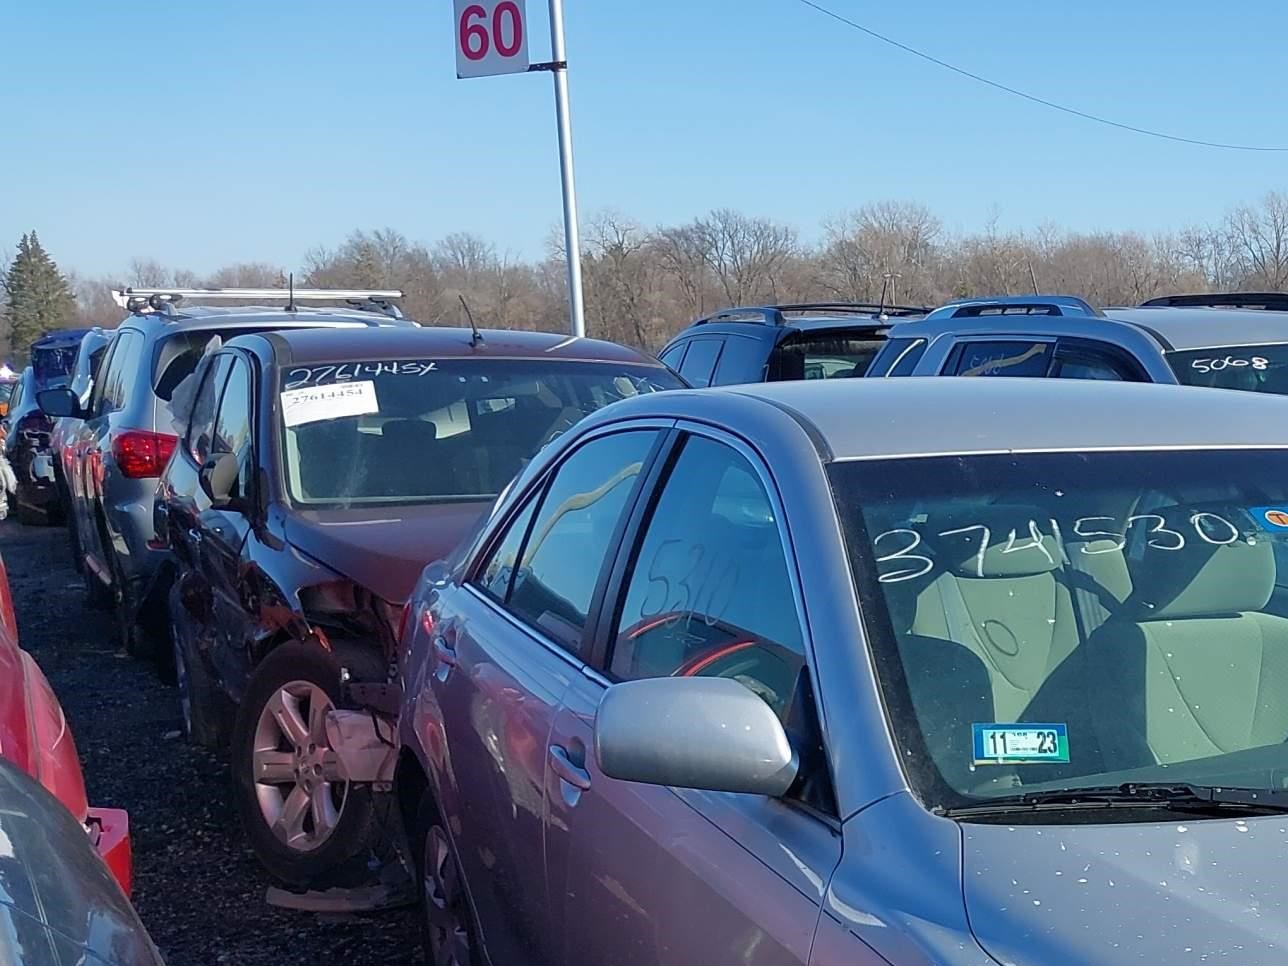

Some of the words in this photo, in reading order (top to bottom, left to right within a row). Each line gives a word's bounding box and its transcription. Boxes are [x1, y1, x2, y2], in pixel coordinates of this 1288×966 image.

[460, 2, 522, 60] 60
[1191, 355, 1269, 373] 5068
[990, 731, 1008, 754] 11
[1037, 731, 1058, 754] 23
